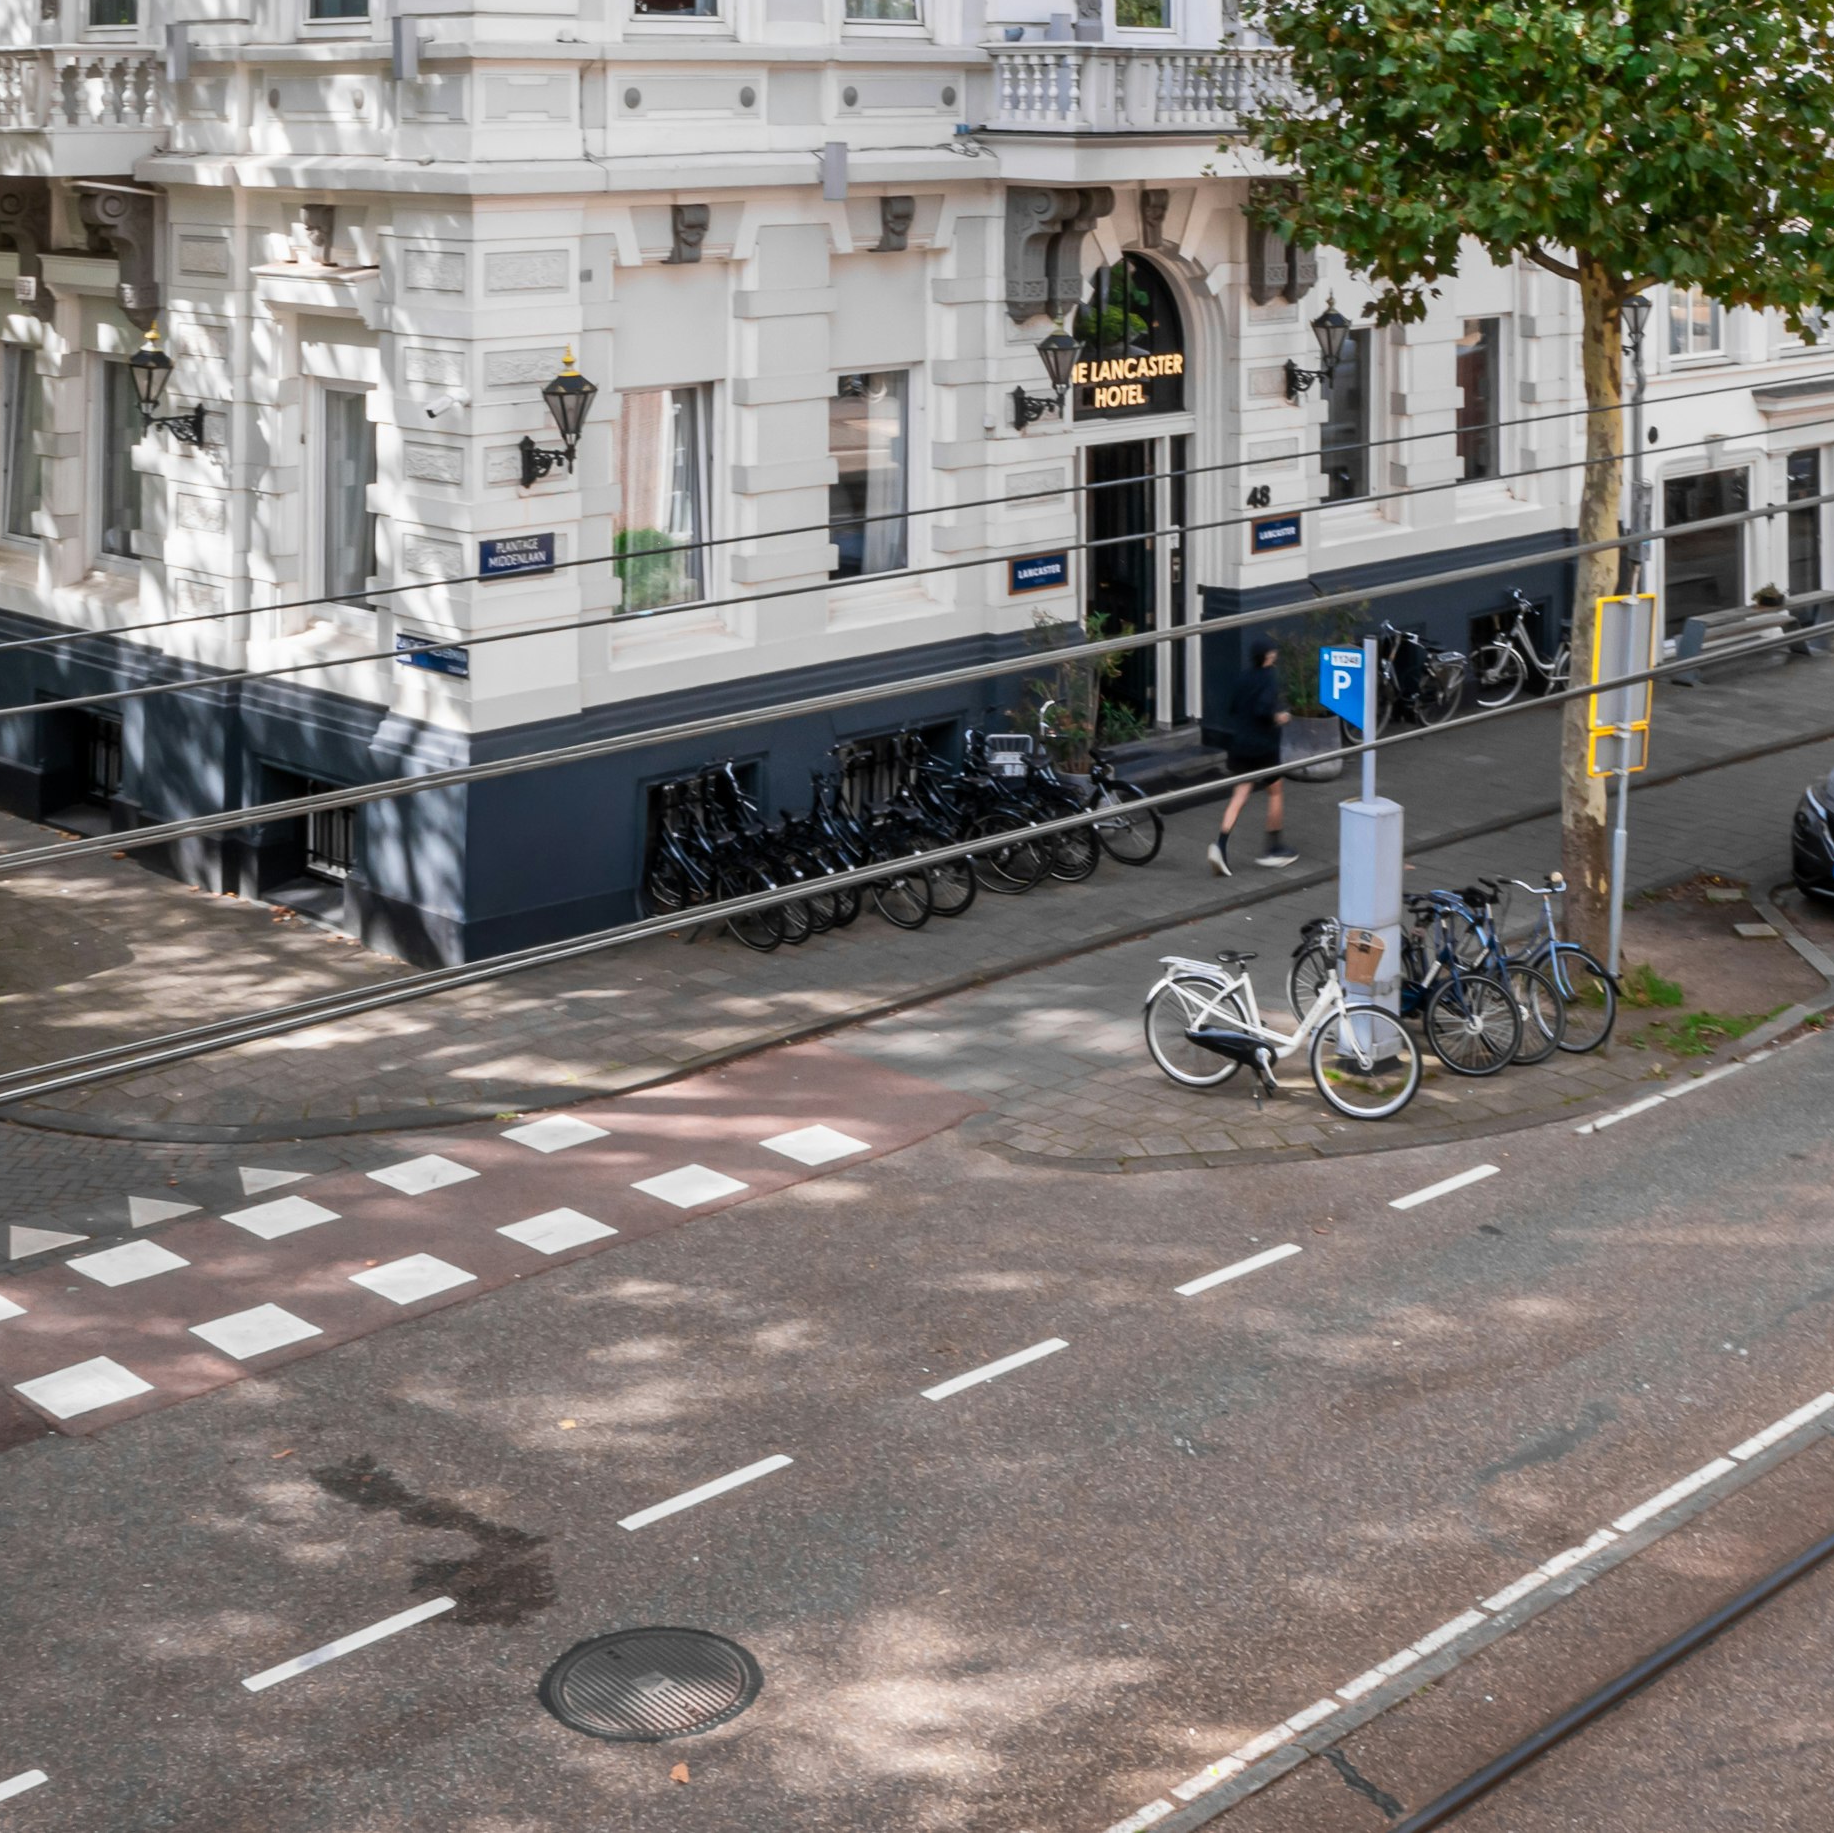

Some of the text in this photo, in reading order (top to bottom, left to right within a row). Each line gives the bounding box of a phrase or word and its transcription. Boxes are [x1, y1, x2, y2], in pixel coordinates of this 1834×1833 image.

[1090, 353, 1184, 382] LANCASTER
[1094, 384, 1146, 408] HOTEL
[1246, 484, 1271, 508] 48
[1258, 526, 1297, 541] LANCASTER
[495, 538, 539, 554] PLANTAGE
[488, 550, 547, 568] MIDDENLAAN
[1017, 563, 1062, 580] LANCASTER
[1333, 669, 1352, 700] P
